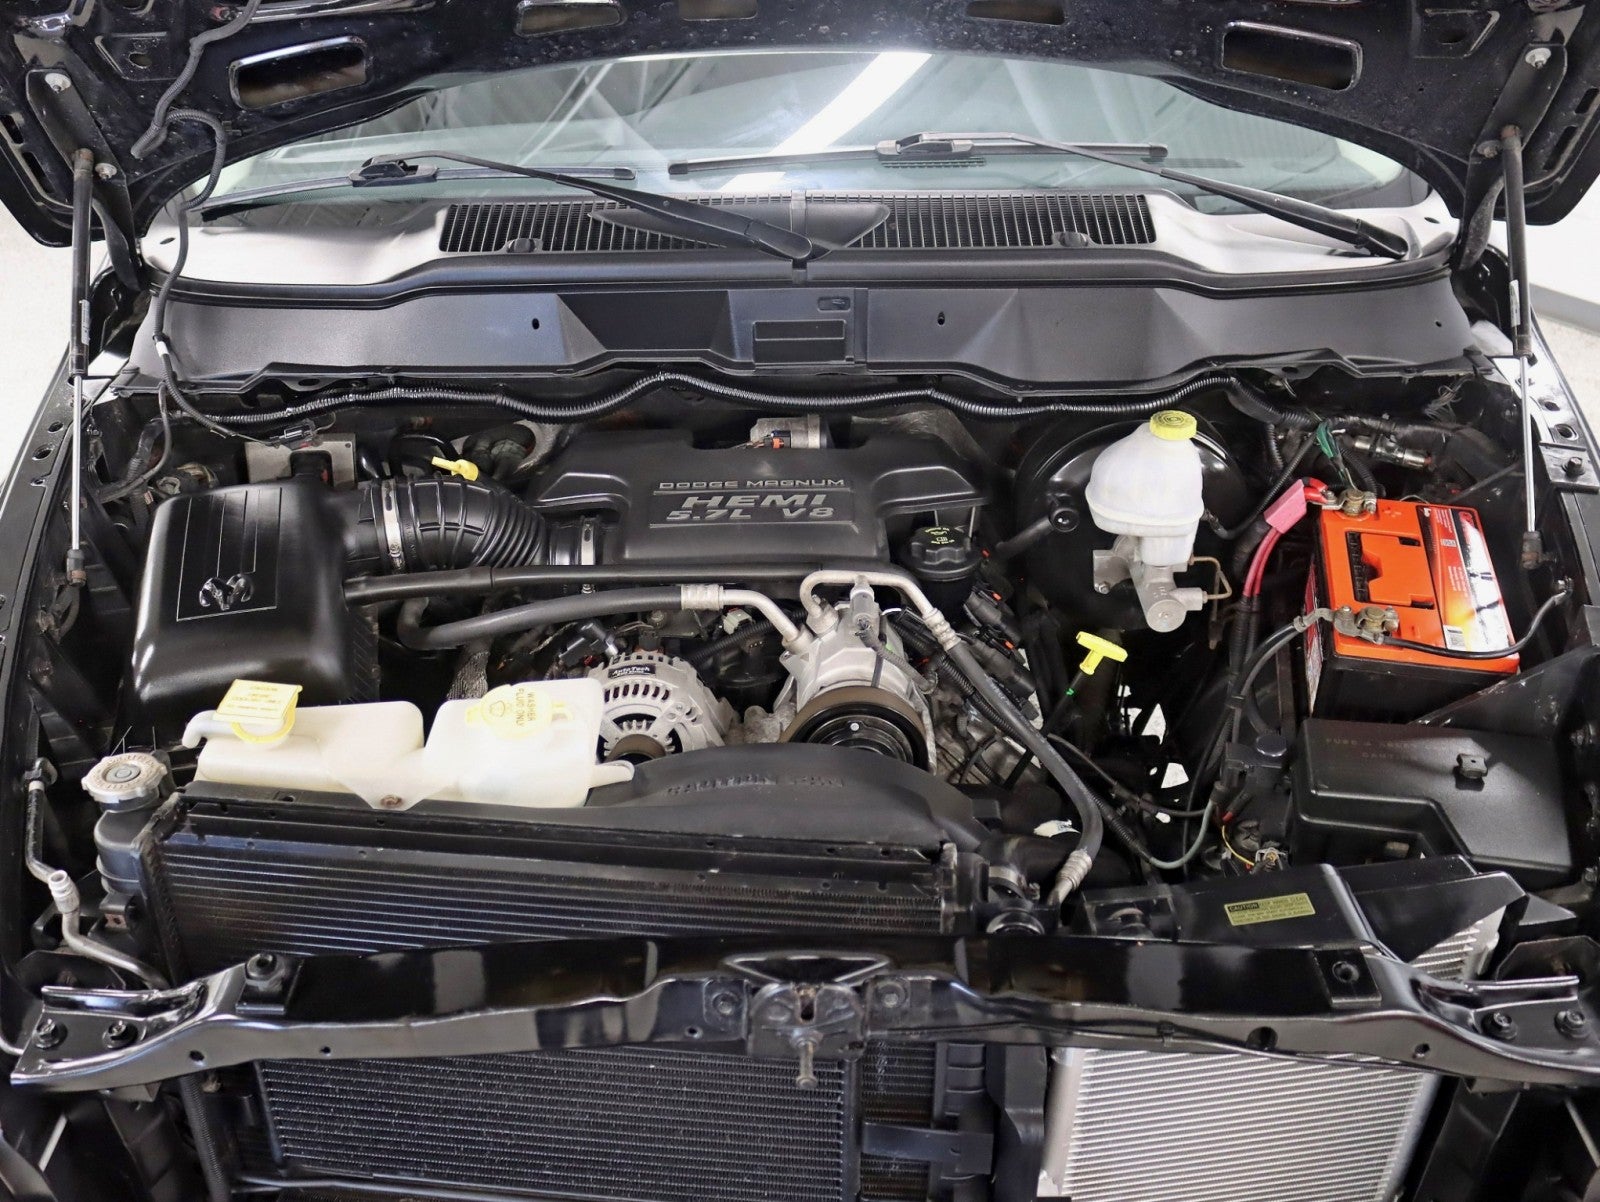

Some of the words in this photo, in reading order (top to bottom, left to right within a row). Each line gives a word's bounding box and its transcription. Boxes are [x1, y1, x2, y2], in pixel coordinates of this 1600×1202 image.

[659, 480, 739, 489] DODGE
[746, 479, 845, 487] MAGNUM
[681, 494, 827, 508] HEMI
[666, 508, 752, 521] 5.7L
[782, 507, 835, 519] V8
[1229, 903, 1258, 912] CAUTION
